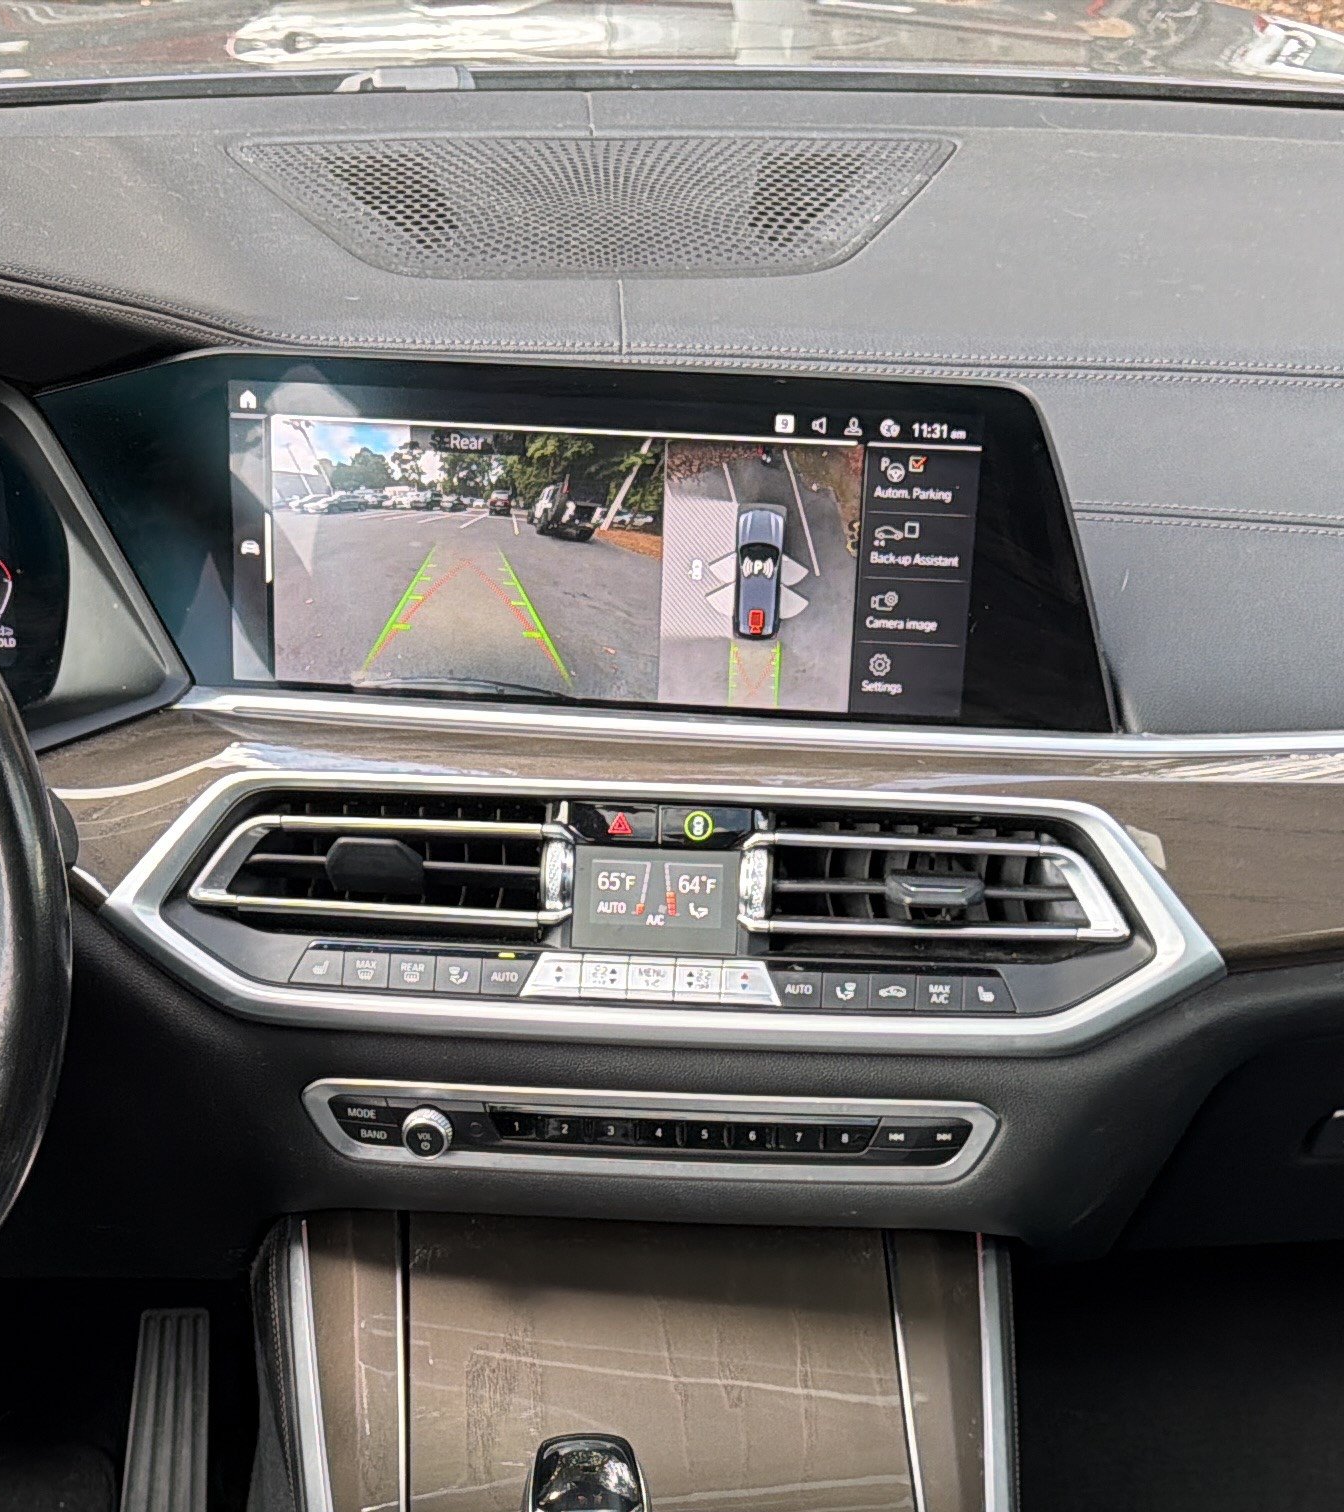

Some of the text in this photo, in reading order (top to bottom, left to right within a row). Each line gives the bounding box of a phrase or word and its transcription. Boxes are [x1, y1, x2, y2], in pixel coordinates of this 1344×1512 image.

[781, 418, 789, 430] 9
[912, 422, 967, 440] 11:31 am
[450, 433, 484, 450] Rear
[874, 485, 953, 504] Autom. Parking
[870, 551, 959, 568] Back-up Assistant
[866, 616, 938, 632] Camera image
[861, 680, 903, 695] Settings
[597, 871, 717, 894] 65°F 64°F
[596, 901, 627, 914] AUTO
[645, 914, 665, 926] A/C
[356, 960, 377, 970] MAX
[401, 962, 425, 973] REAR
[490, 971, 519, 983] AUTO
[784, 983, 813, 996] AUTO
[929, 983, 951, 994] MAX
[930, 994, 949, 1005] A/C
[347, 1107, 377, 1119] MODE
[360, 1128, 387, 1140] BAND
[417, 1132, 432, 1141] VOL
[514, 1121, 849, 1144] 1 2 3 4 5 6 7 8
